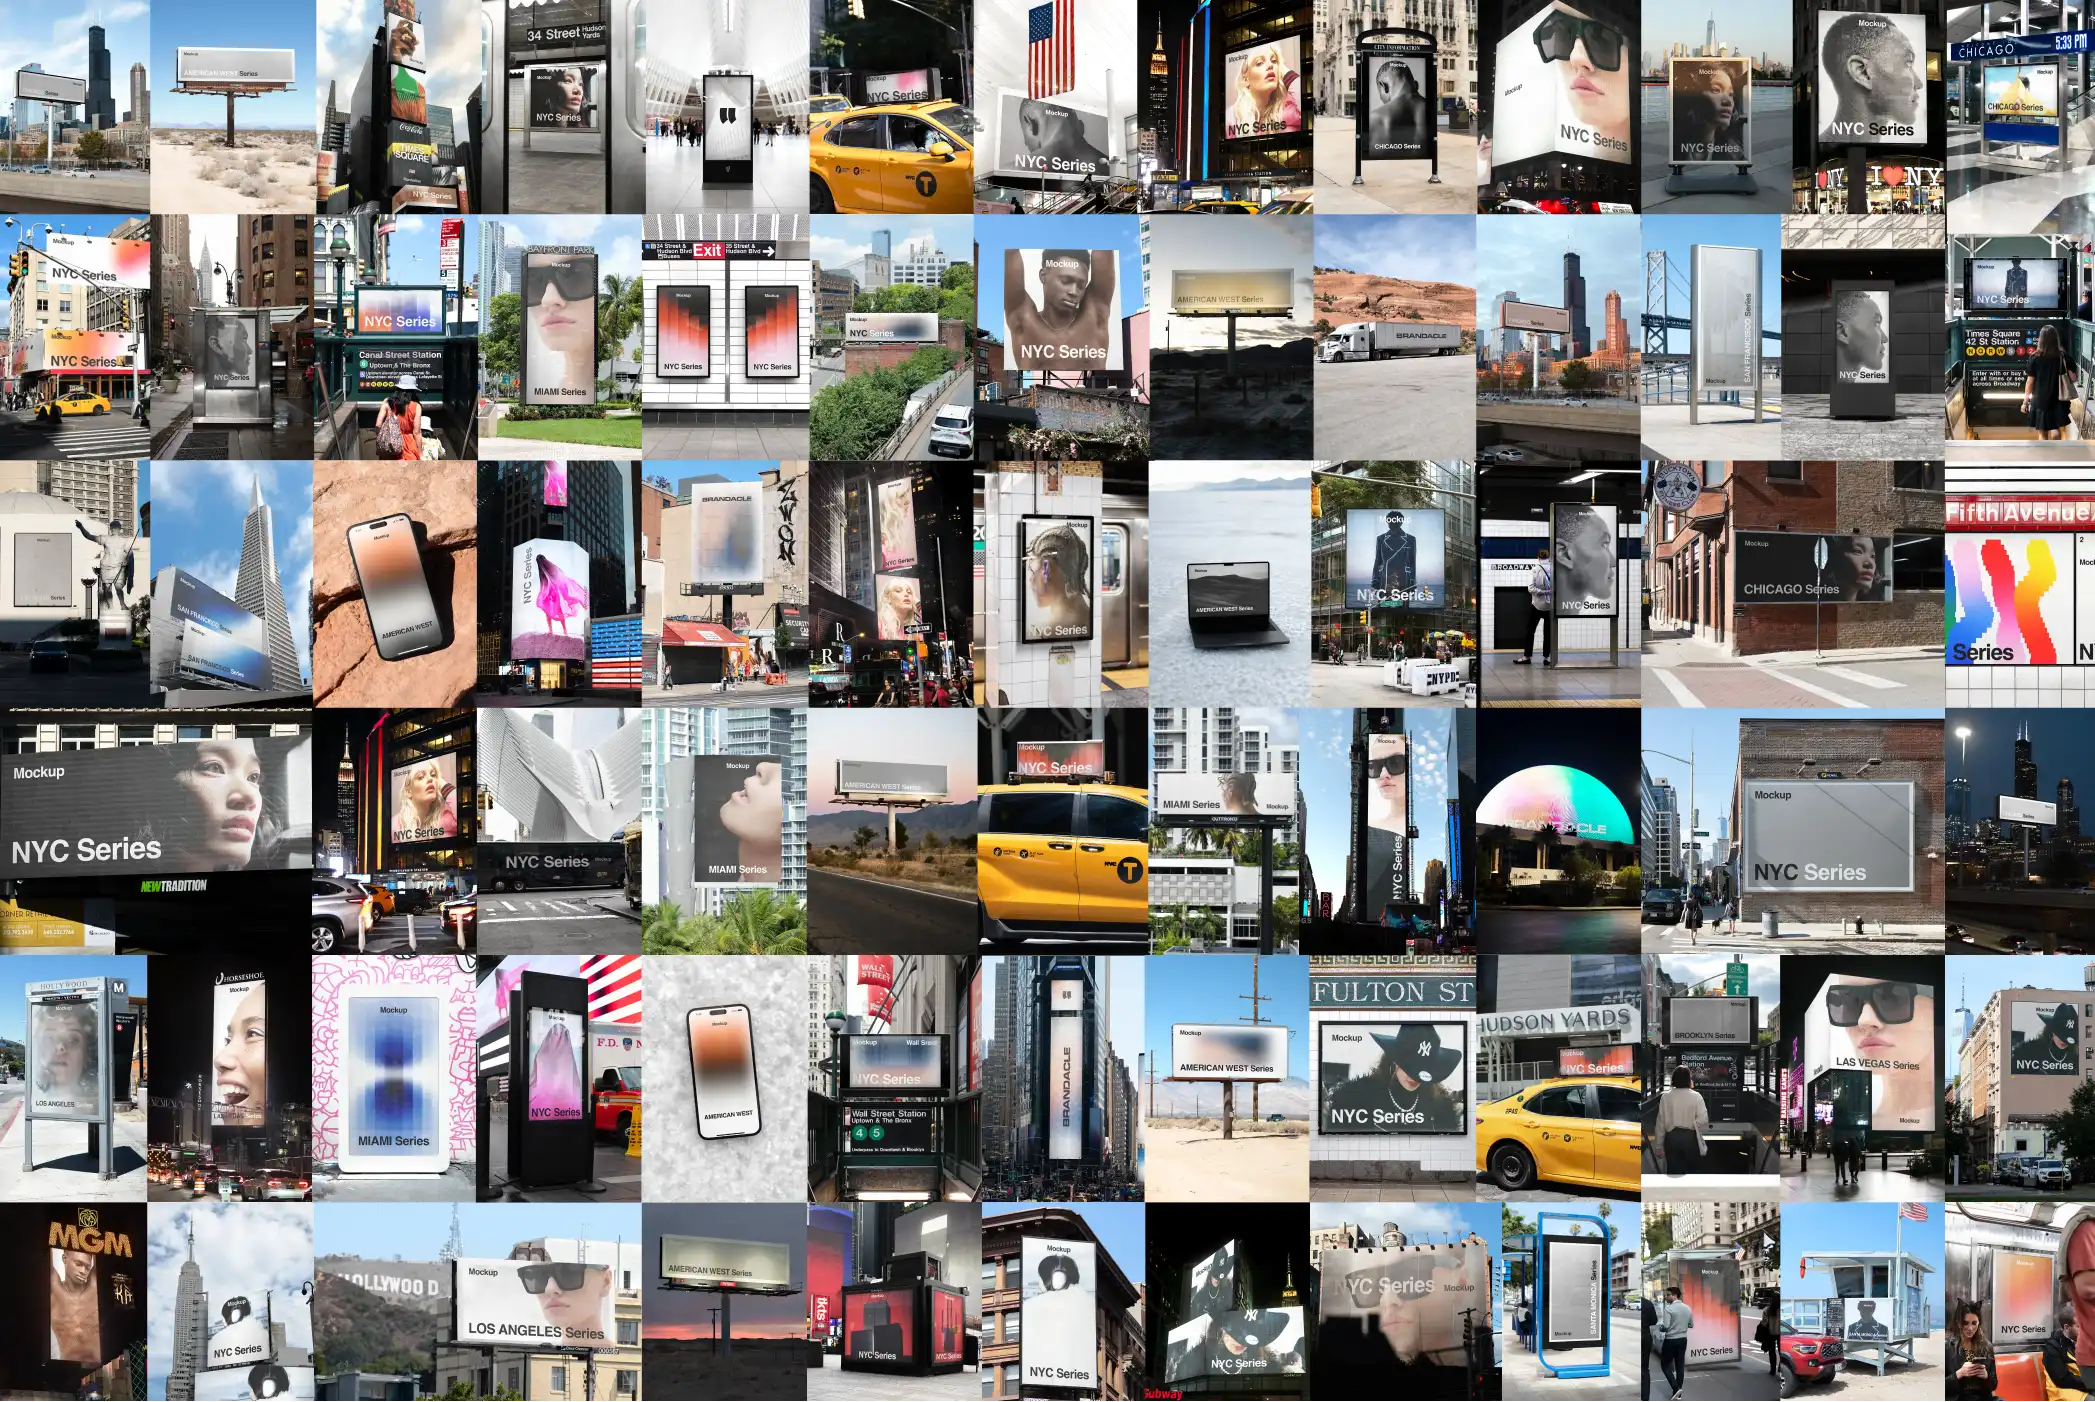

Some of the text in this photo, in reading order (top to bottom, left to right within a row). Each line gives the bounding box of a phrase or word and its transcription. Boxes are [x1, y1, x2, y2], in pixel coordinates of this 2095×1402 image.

[582, 24, 606, 32] Hudson
[1858, 20, 1887, 28] Mockup
[527, 27, 581, 41] 34 Street
[2056, 33, 2087, 50] 5:33 PM
[1959, 44, 2014, 58] CHICAGO
[1988, 103, 2043, 112] CHICAGO Series
[1229, 119, 1287, 136] NYC Series
[1832, 122, 1914, 136] NYC Series
[1560, 124, 1628, 151] NYC Series
[400, 143, 424, 155] TIMES
[1681, 143, 1739, 153] NYC Series
[395, 151, 429, 163] SQUARE
[1015, 154, 1096, 173] NYC Series
[1871, 166, 1944, 186] I NY
[693, 243, 722, 257] Exit
[1046, 260, 1079, 269] Mockup
[1977, 295, 2030, 304] NYC Series
[364, 315, 436, 327] NYC Series
[1966, 330, 2021, 339] Times Square
[1965, 338, 2019, 346] 42 St Station
[359, 351, 442, 359] Canal Street Station
[1021, 345, 1106, 359] NYC Series
[50, 355, 117, 368] NYC Series
[369, 362, 392, 370] Uptown
[1659, 466, 1696, 484] BUCKTOWN
[1945, 502, 2089, 522] Fifth Avenue
[1744, 584, 1839, 595] CHICAGO Series
[1562, 601, 1610, 610] NYC Series
[382, 620, 433, 640] AMERICAN WEST
[1953, 644, 2014, 661] Series
[1432, 671, 1454, 685] NYPD
[726, 762, 750, 770] Mockup
[13, 766, 65, 780] Mockup
[1755, 790, 1792, 801] Mockup
[1163, 800, 1220, 809] MIAMI Series
[394, 826, 444, 840] NYC Series
[12, 837, 162, 864] NYC Series
[505, 855, 590, 869] NYC Series
[1393, 835, 1403, 900] NYC Series
[709, 865, 767, 874] MIAMI Series
[1755, 863, 1867, 881] NYC Series
[141, 879, 207, 893] NEWTRADITION
[861, 963, 884, 974] WALL
[223, 972, 265, 982] HORSESHOE
[861, 971, 892, 983] STREET
[40, 980, 88, 990] HOLLYWOOD
[1313, 981, 1474, 1002] FULTON ST
[380, 1006, 408, 1015] Mockup
[1561, 1008, 1630, 1029] YARDS
[1332, 1034, 1362, 1043] Mockup
[1675, 1032, 1714, 1040] BROOKLYN
[597, 1037, 619, 1048] F.D.
[1180, 1064, 1224, 1072] AMERICAN
[1250, 1065, 1274, 1073] Series
[1836, 1057, 1920, 1071] LAS VEGAS Series
[2016, 1060, 2074, 1070] NYC Series
[1062, 1047, 1071, 1127] BRANDACLE
[531, 1107, 581, 1117] NYC Series
[852, 1110, 926, 1118] Wall Street Station
[1331, 1109, 1425, 1124] NYC Series
[358, 1135, 430, 1146] MIAMI Series
[48, 1221, 133, 1258] MGM
[469, 1268, 498, 1277] Mockup
[668, 1264, 752, 1277] AMERICAN WEST Series
[1444, 1284, 1475, 1292] Mockup
[469, 1323, 605, 1340] LOS ANGELES Series
[2001, 1325, 2046, 1334] NYC Series
[214, 1344, 262, 1359] NYC Series
[858, 1351, 897, 1360] NYC Series
[1690, 1346, 1733, 1357] NYC Series
[1029, 1367, 1089, 1380] NYC Series
[1144, 1388, 1183, 1401] Subway
